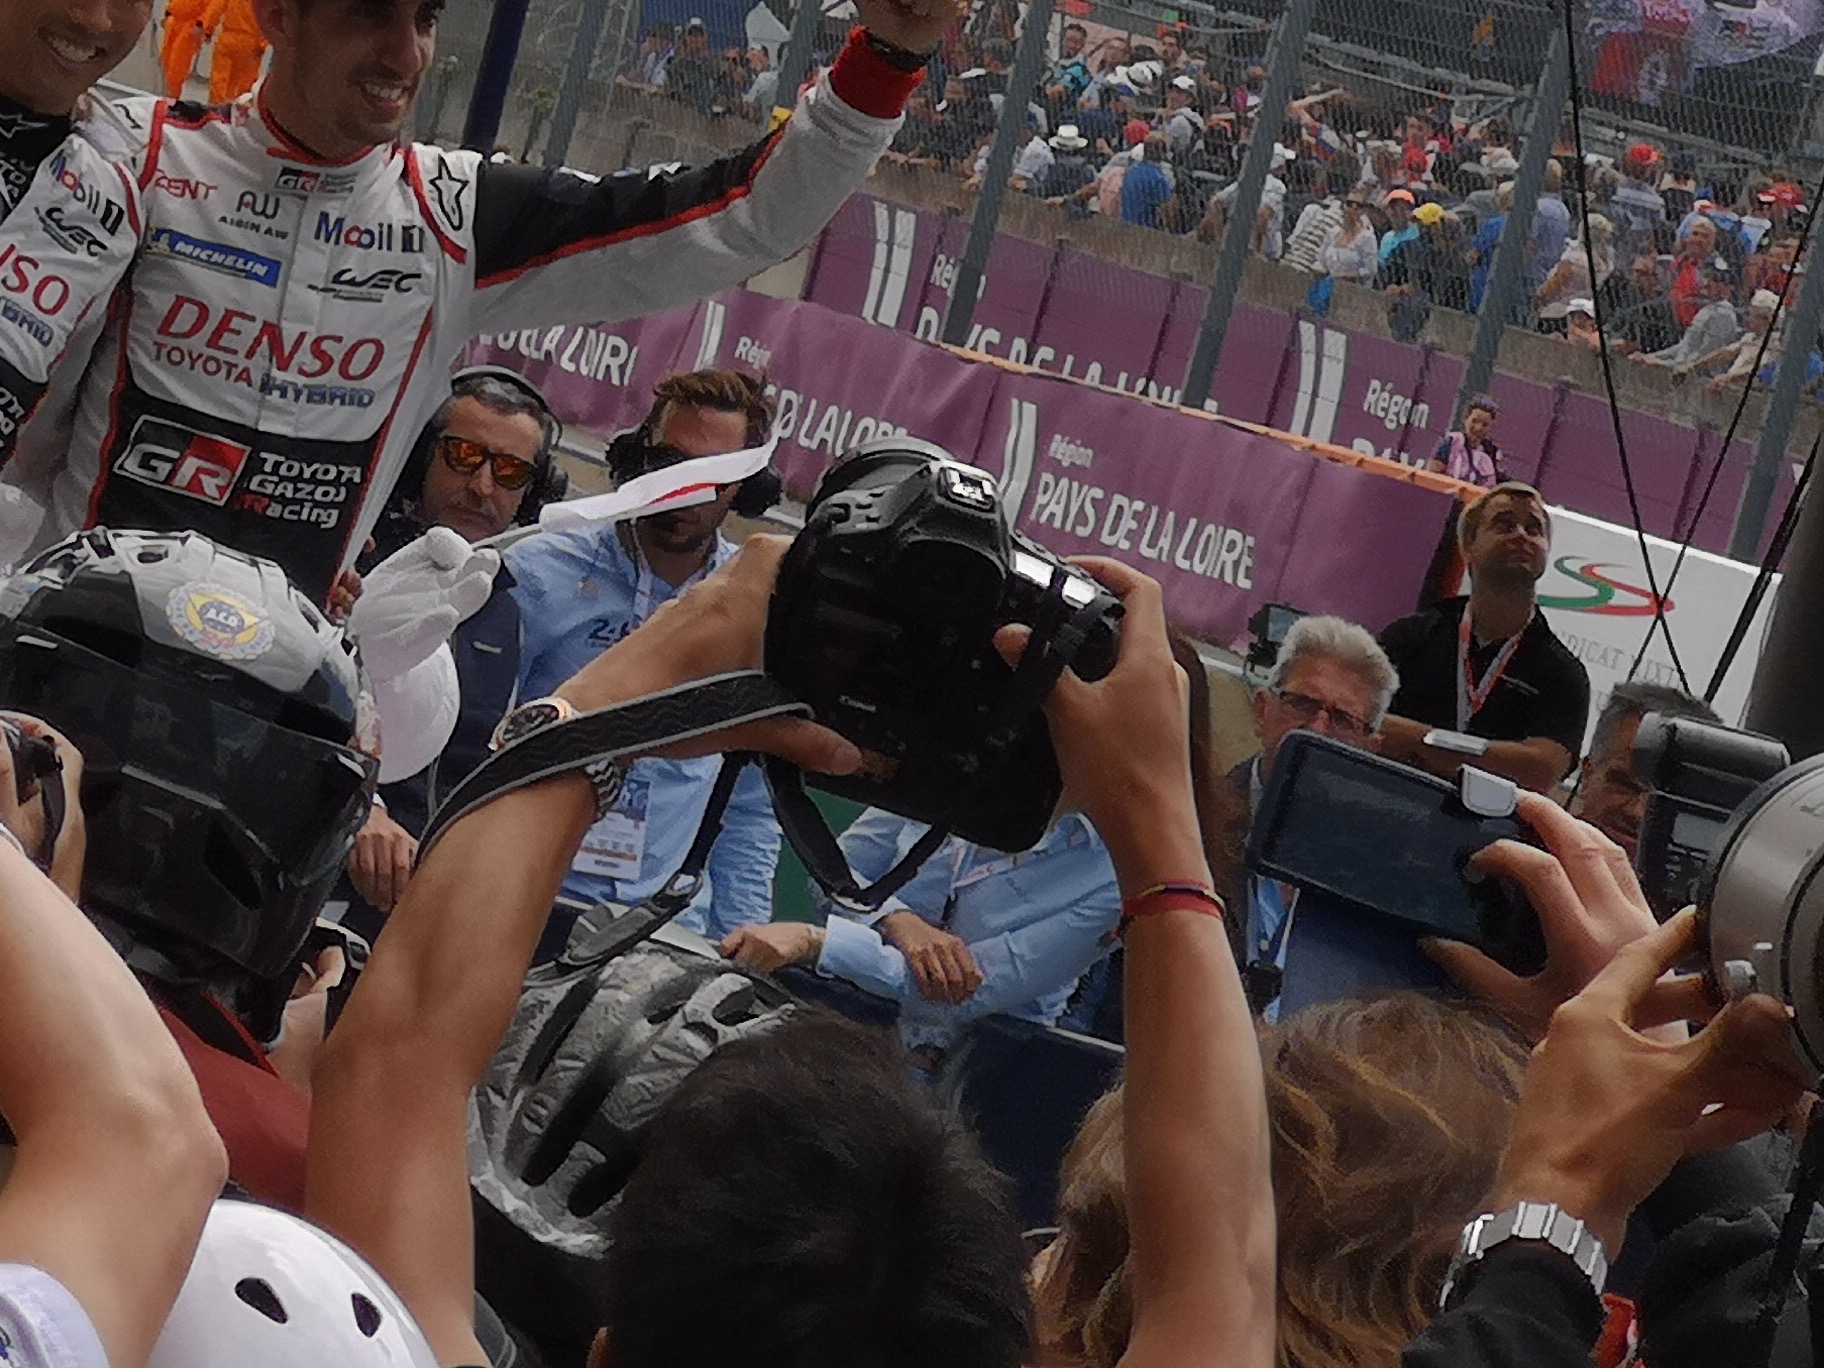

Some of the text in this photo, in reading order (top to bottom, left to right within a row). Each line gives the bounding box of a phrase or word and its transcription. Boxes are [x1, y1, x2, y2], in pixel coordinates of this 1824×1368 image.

[314, 211, 393, 249] Mobil
[175, 240, 269, 277] MICHELIN
[331, 267, 422, 294] WEC
[156, 293, 385, 381] DENSO
[153, 340, 376, 409] TOYOTA HYBRID
[1048, 433, 1094, 468] Région
[123, 442, 232, 501] GR
[241, 494, 341, 529] Racing
[1029, 472, 1256, 591] PAYS DE LA LOIRE
